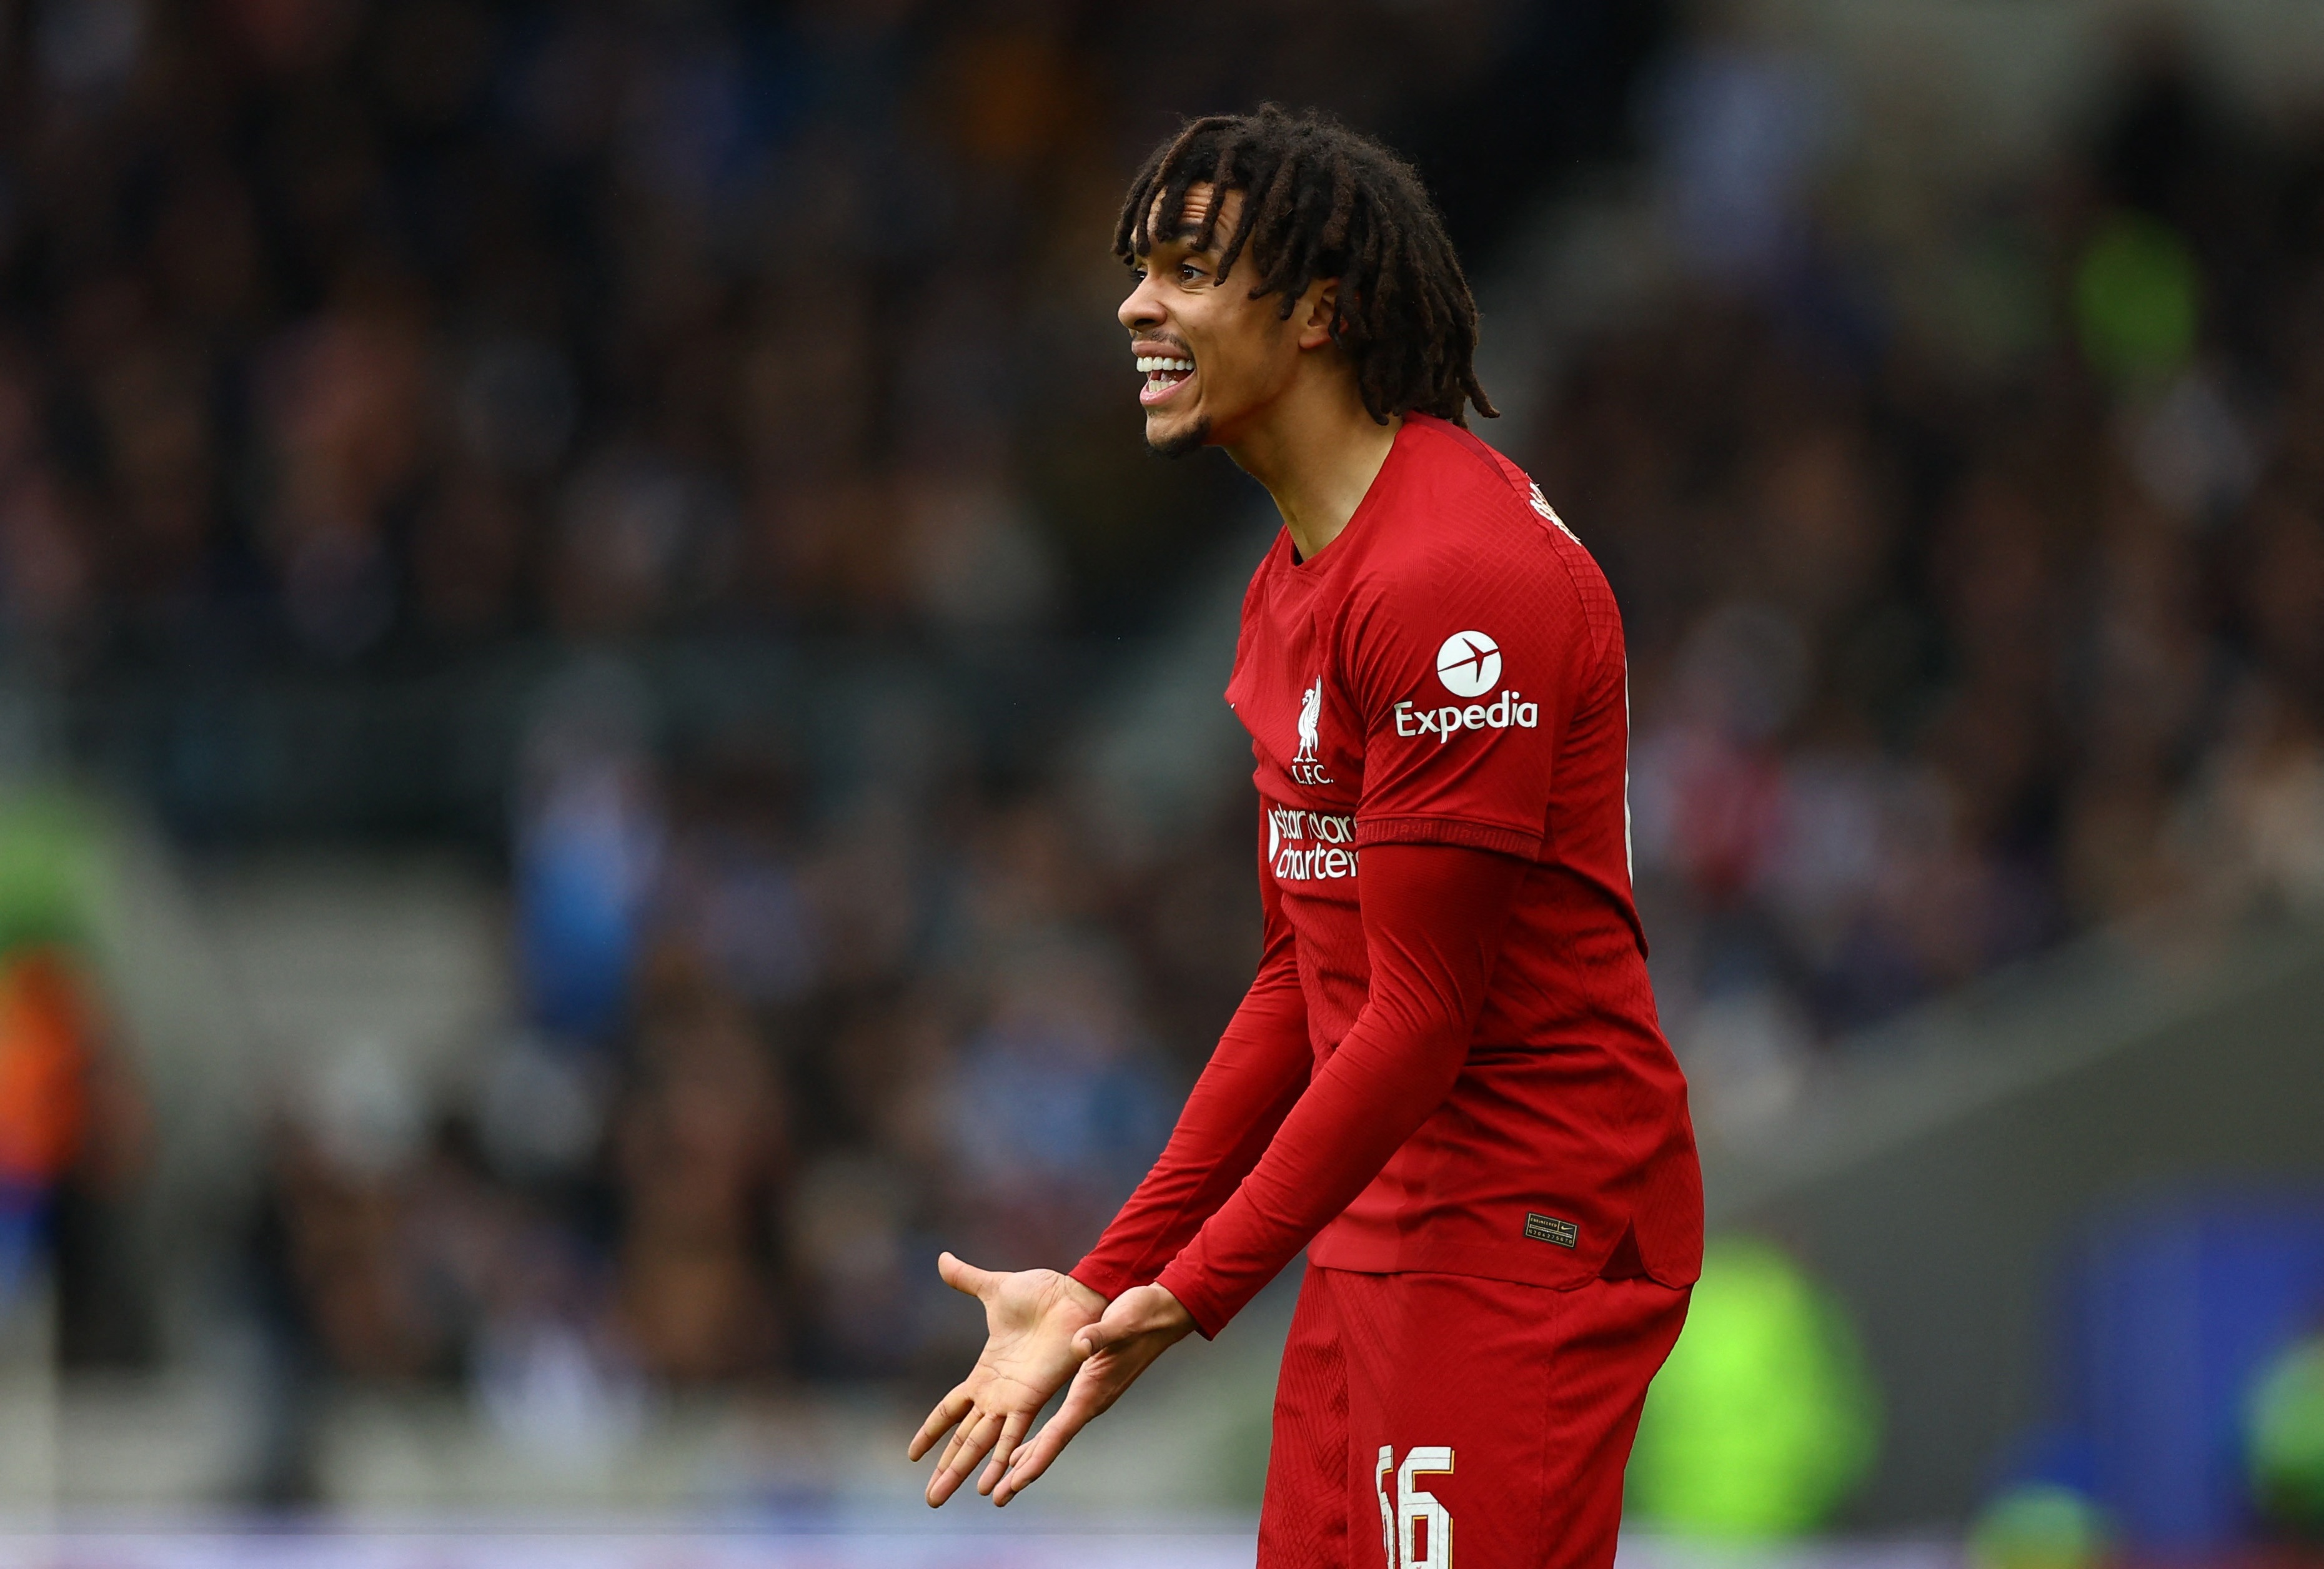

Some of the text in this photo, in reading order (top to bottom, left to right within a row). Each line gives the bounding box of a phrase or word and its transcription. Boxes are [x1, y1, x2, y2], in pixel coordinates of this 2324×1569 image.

[1394, 690, 1538, 744] Expedia
[1291, 765, 1334, 784] L.F.C.
[1274, 803, 1357, 844] standar
[1276, 841, 1359, 880] charter
